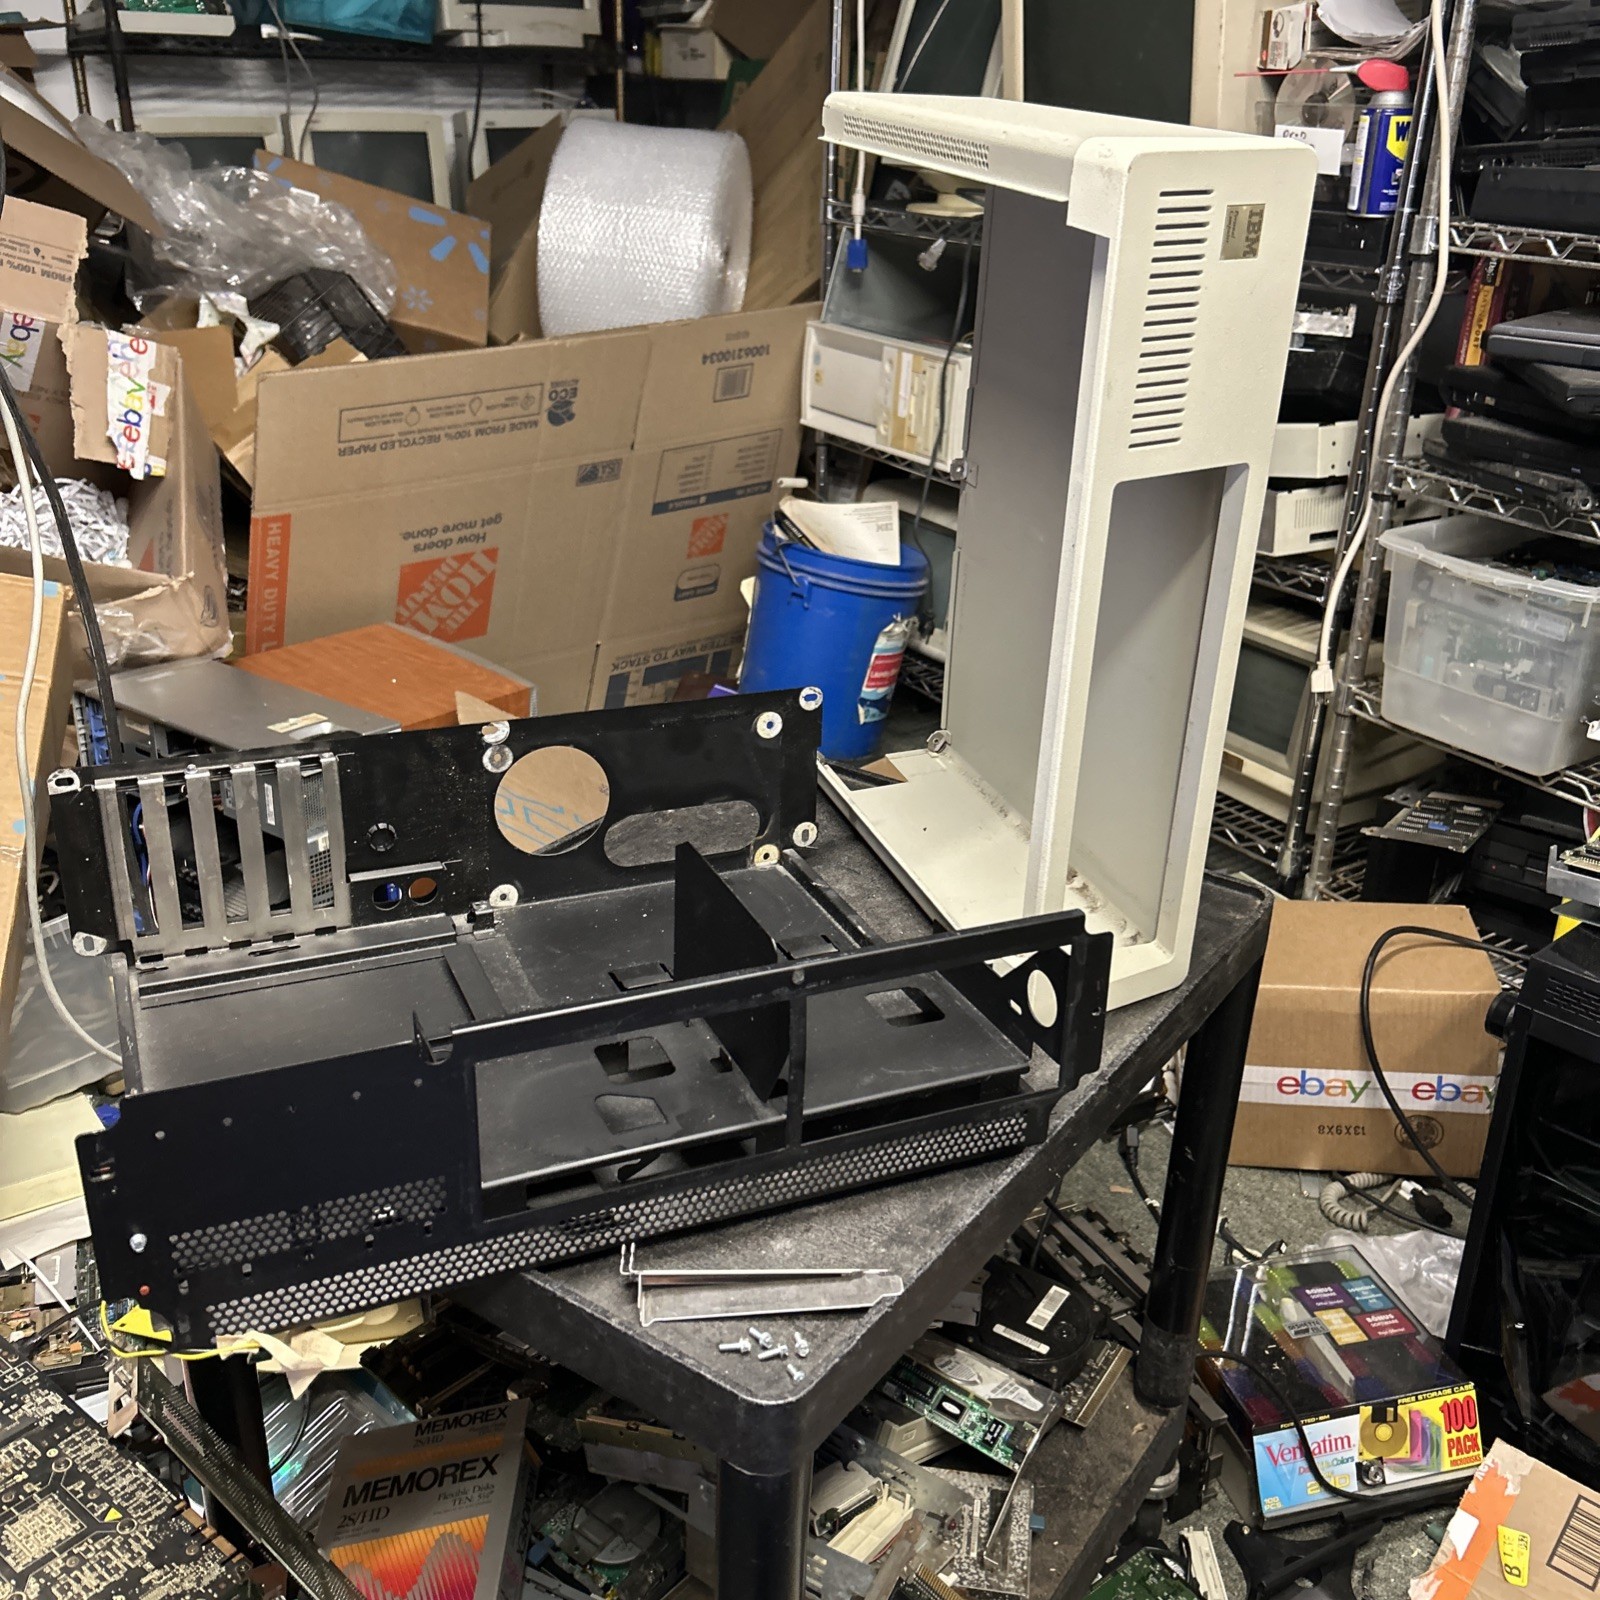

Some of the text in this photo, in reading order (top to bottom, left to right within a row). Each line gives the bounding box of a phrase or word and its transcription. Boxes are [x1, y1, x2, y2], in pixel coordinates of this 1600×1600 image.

[1242, 209, 1264, 257] IBM
[701, 344, 770, 365] 1006210034
[548, 386, 578, 400] ECO
[474, 422, 506, 438] FROM
[508, 418, 539, 433] MADE
[379, 433, 442, 452] RECYCLED
[443, 429, 472, 442] 100%
[338, 441, 377, 457] PAPER
[442, 520, 477, 533] more
[480, 512, 503, 528] get
[265, 522, 282, 581] HEAVY
[413, 532, 487, 553] How doers
[403, 551, 497, 633] HOM
[262, 587, 278, 633] DUTY
[653, 652, 671, 662] TO
[671, 644, 697, 658] WAY
[611, 654, 651, 672] STACK
[1277, 1070, 1371, 1103] ebay
[1411, 1075, 1496, 1109] ebay
[1317, 1124, 1366, 1136] 13X9X8
[1305, 1286, 1333, 1296] BONUS
[1287, 1320, 1321, 1331] DISKETTE
[1366, 1313, 1395, 1323] BONUS
[1398, 1384, 1474, 1405] FREE STORAGE CASE
[414, 1405, 510, 1437] MEMOREX
[1439, 1395, 1477, 1434] 100
[1447, 1433, 1480, 1457] PACK
[1450, 1454, 1481, 1467] MICRODISKS
[342, 1453, 500, 1508] MEMOREX
[1307, 1474, 1351, 1495] 2D
[438, 1482, 495, 1502] Flexible Disks
[451, 1495, 472, 1507] TEN
[336, 1505, 390, 1529] 2S/HD
[1505, 1563, 1522, 1579] B
